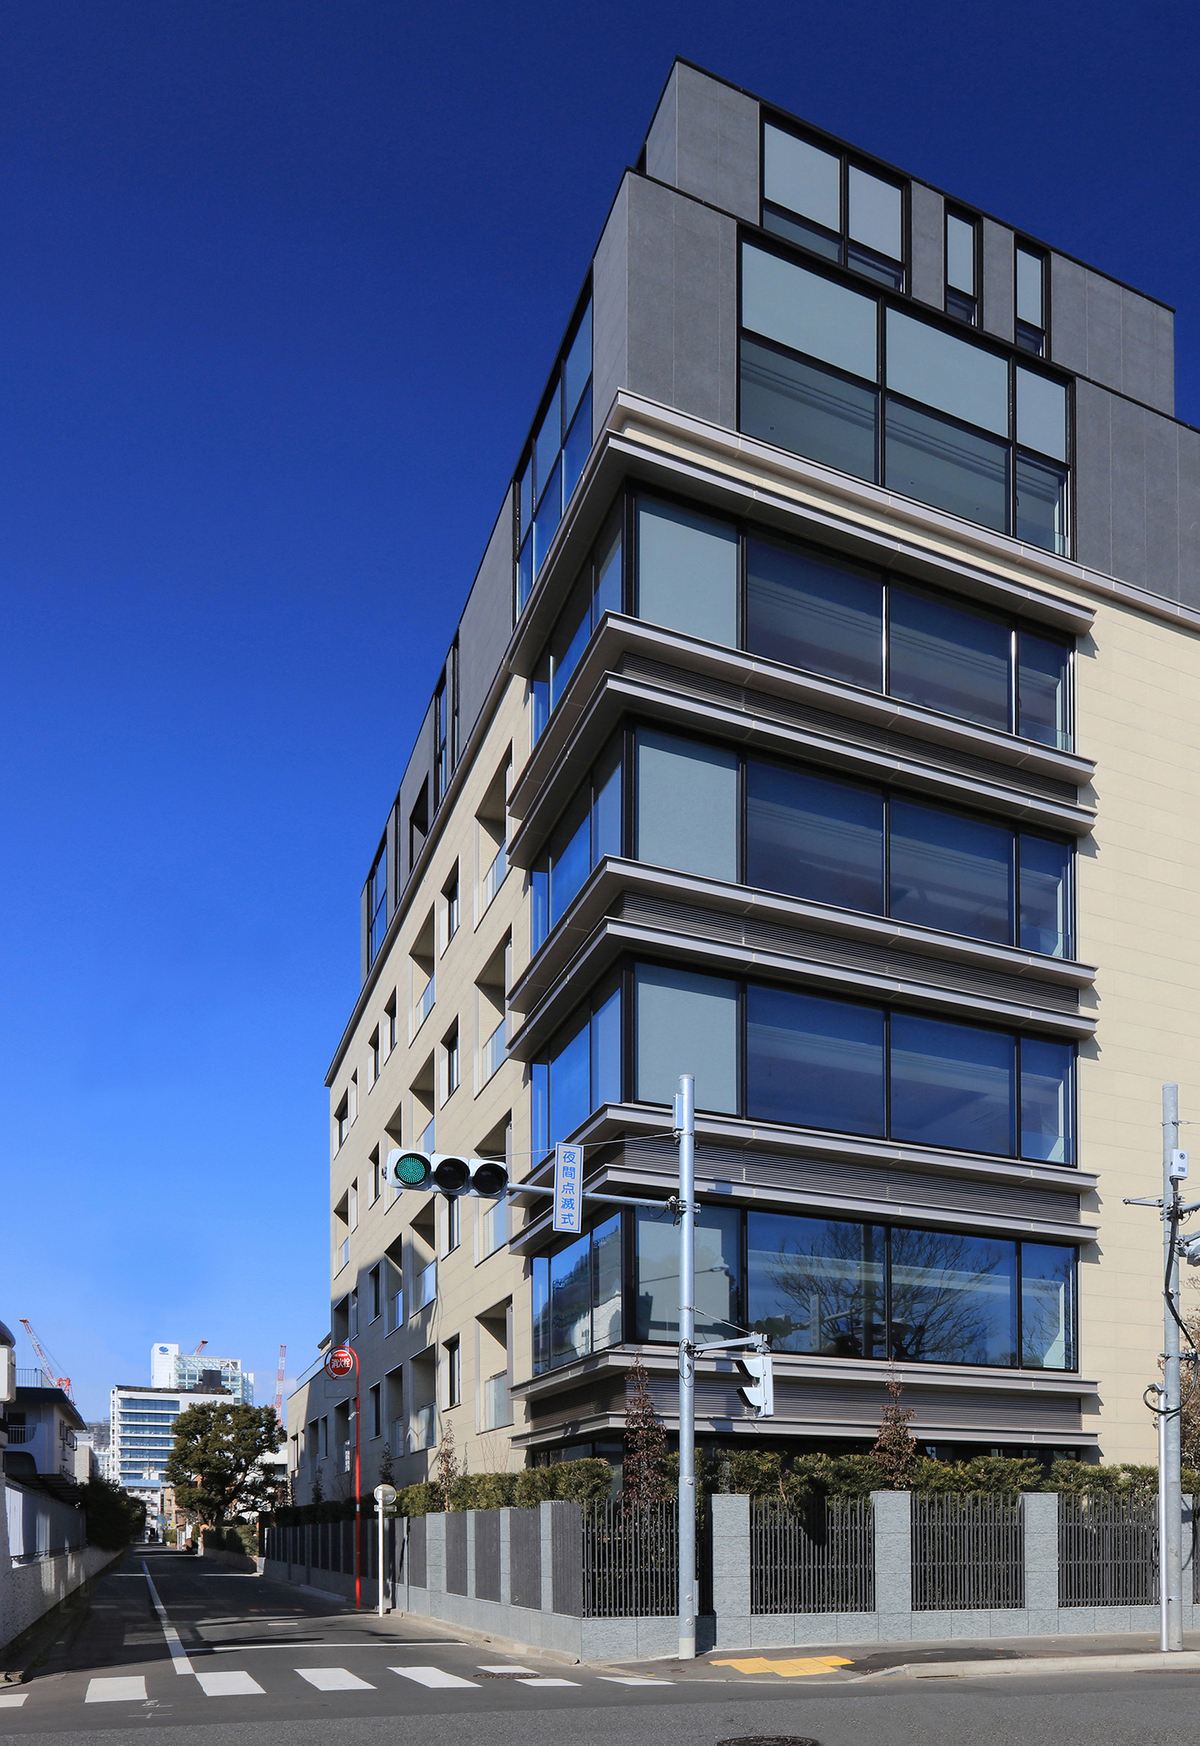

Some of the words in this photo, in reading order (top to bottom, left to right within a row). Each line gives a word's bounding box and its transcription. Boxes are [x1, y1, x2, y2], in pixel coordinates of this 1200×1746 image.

[561, 1150, 576, 1226] 夜間点滅式
[331, 1357, 351, 1369] 消火栓
